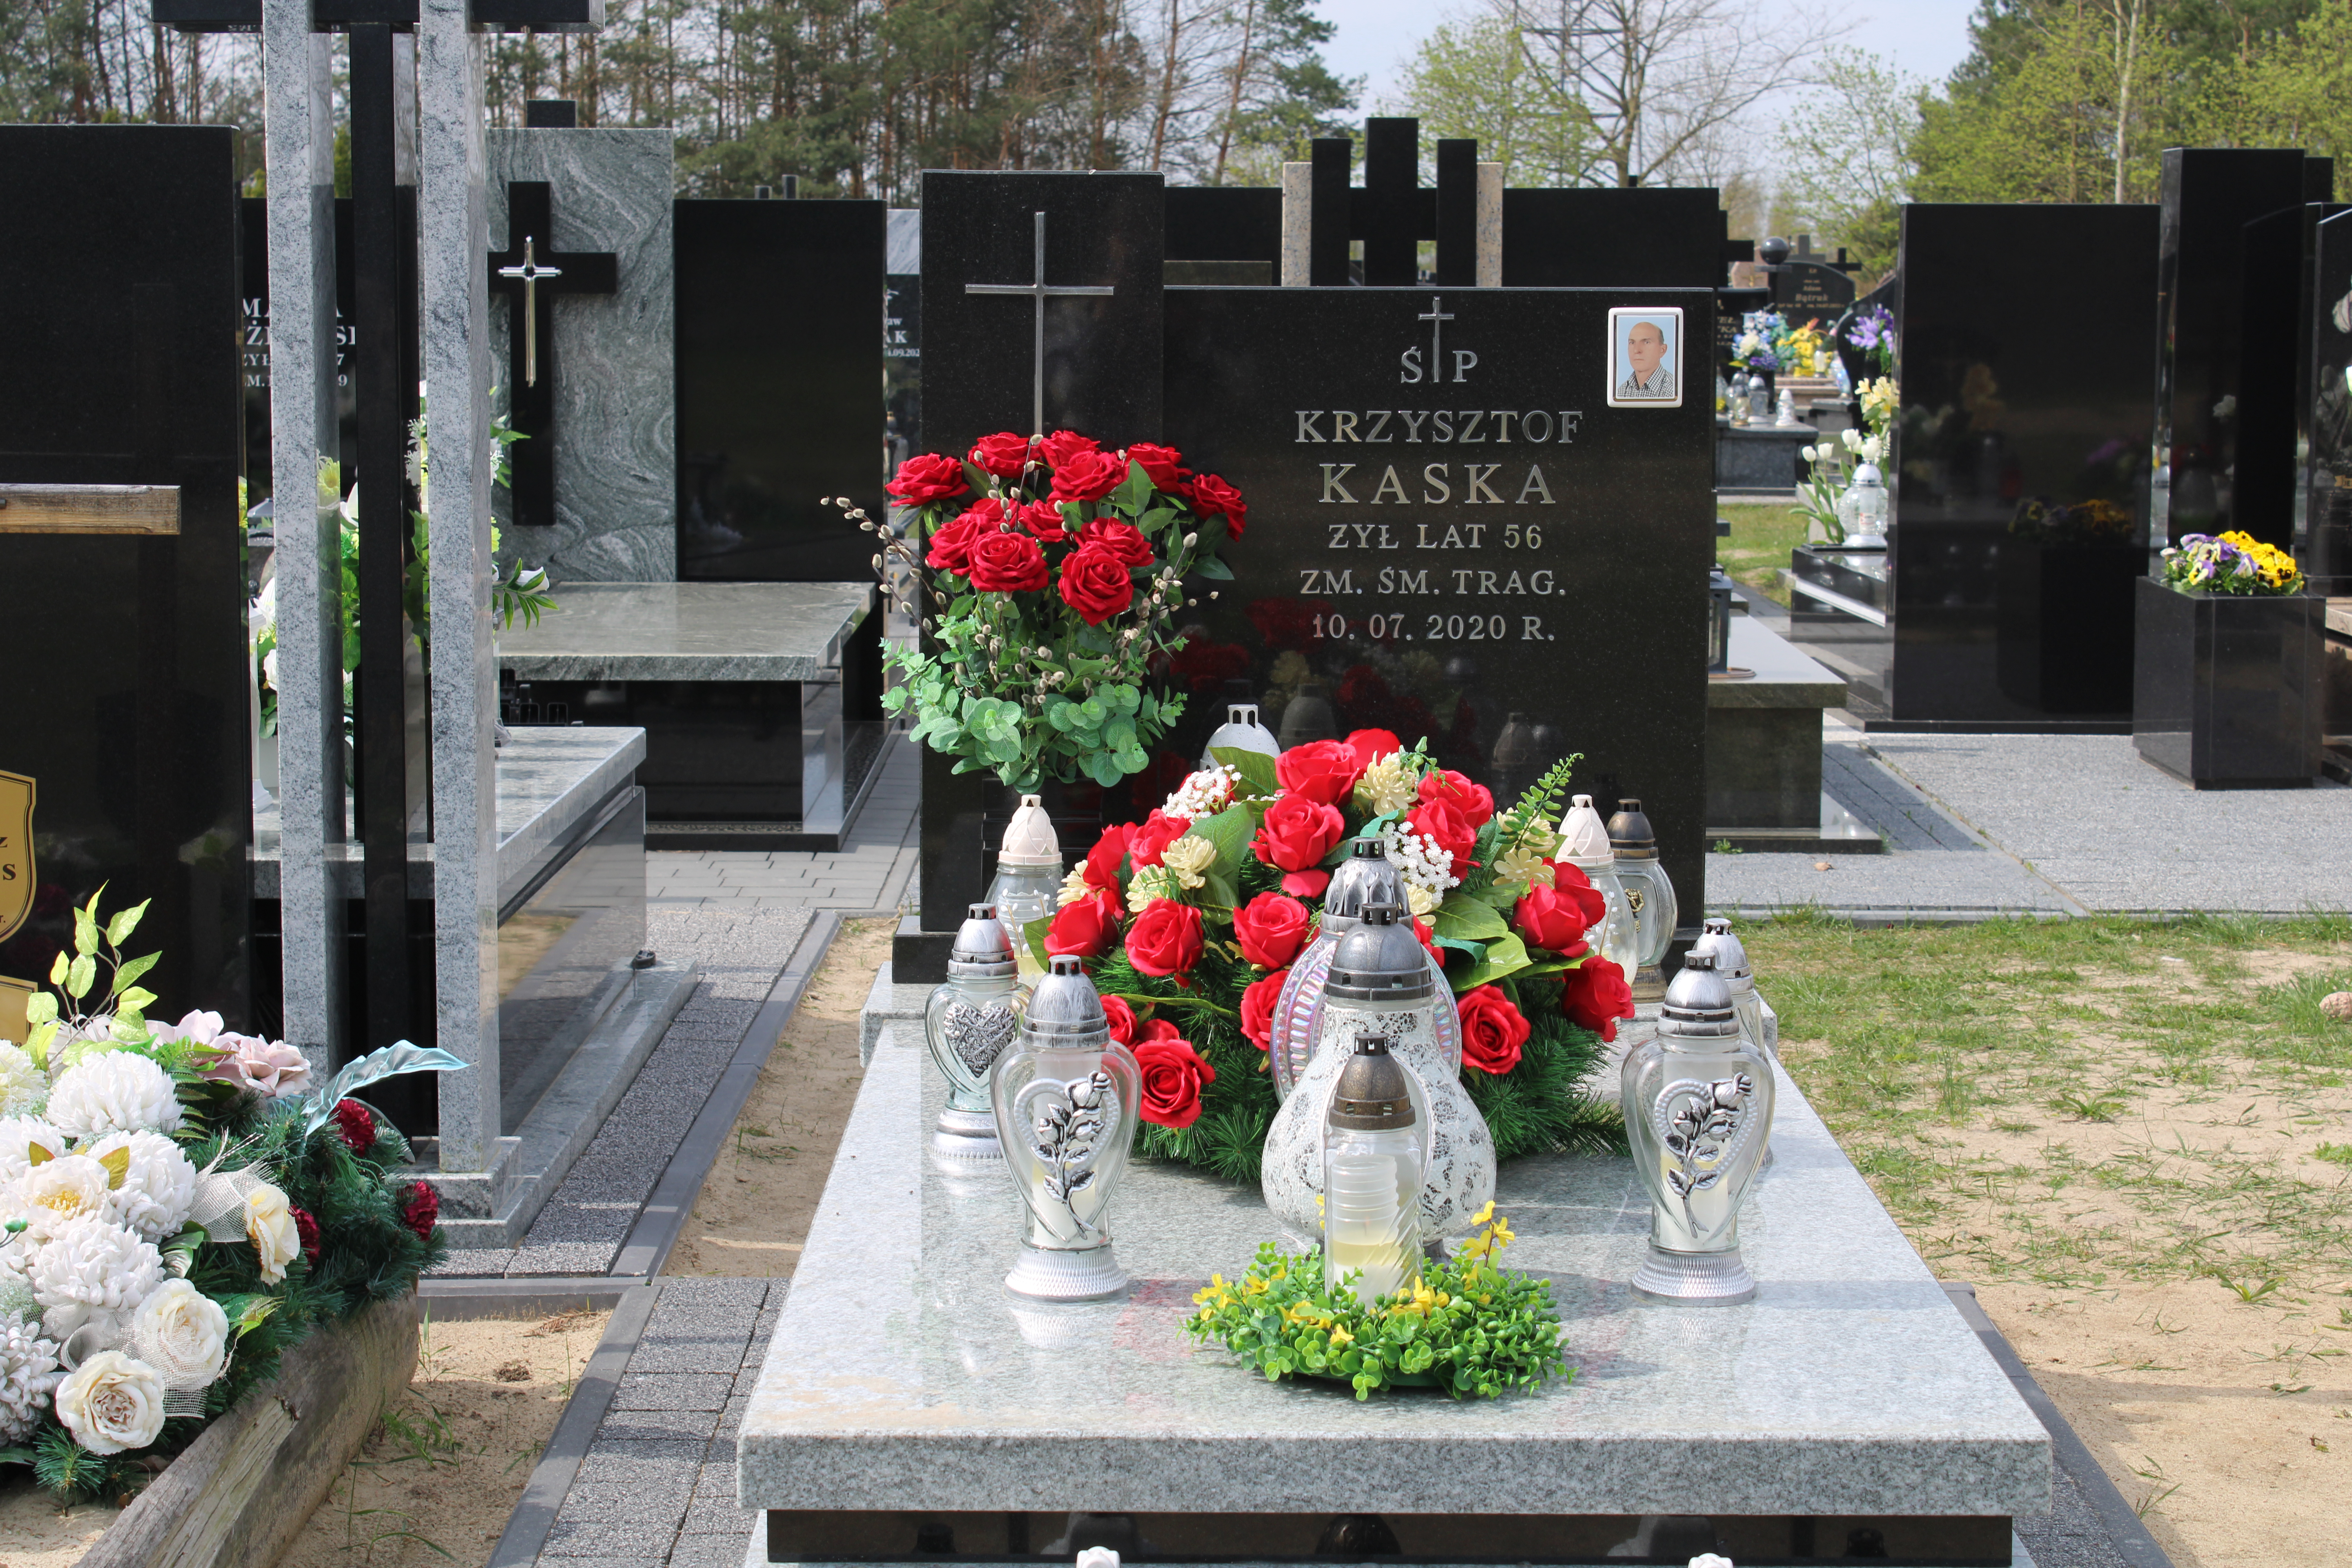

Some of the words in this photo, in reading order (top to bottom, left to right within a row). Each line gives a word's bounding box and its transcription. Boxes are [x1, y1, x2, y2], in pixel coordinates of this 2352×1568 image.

[1401, 346, 1422, 383] Ś
[1452, 350, 1477, 382] P
[1295, 410, 1583, 443] KRZYSZTOF
[1318, 463, 1556, 504] KASKA
[1416, 524, 1486, 548] LAT
[1504, 524, 1541, 549] 56
[1300, 570, 1362, 594] ZM.
[1378, 566, 1439, 595] ŚM.
[1452, 570, 1566, 595] TRAG.
[1426, 614, 1506, 640] 2020
[1521, 616, 1555, 641] R.
